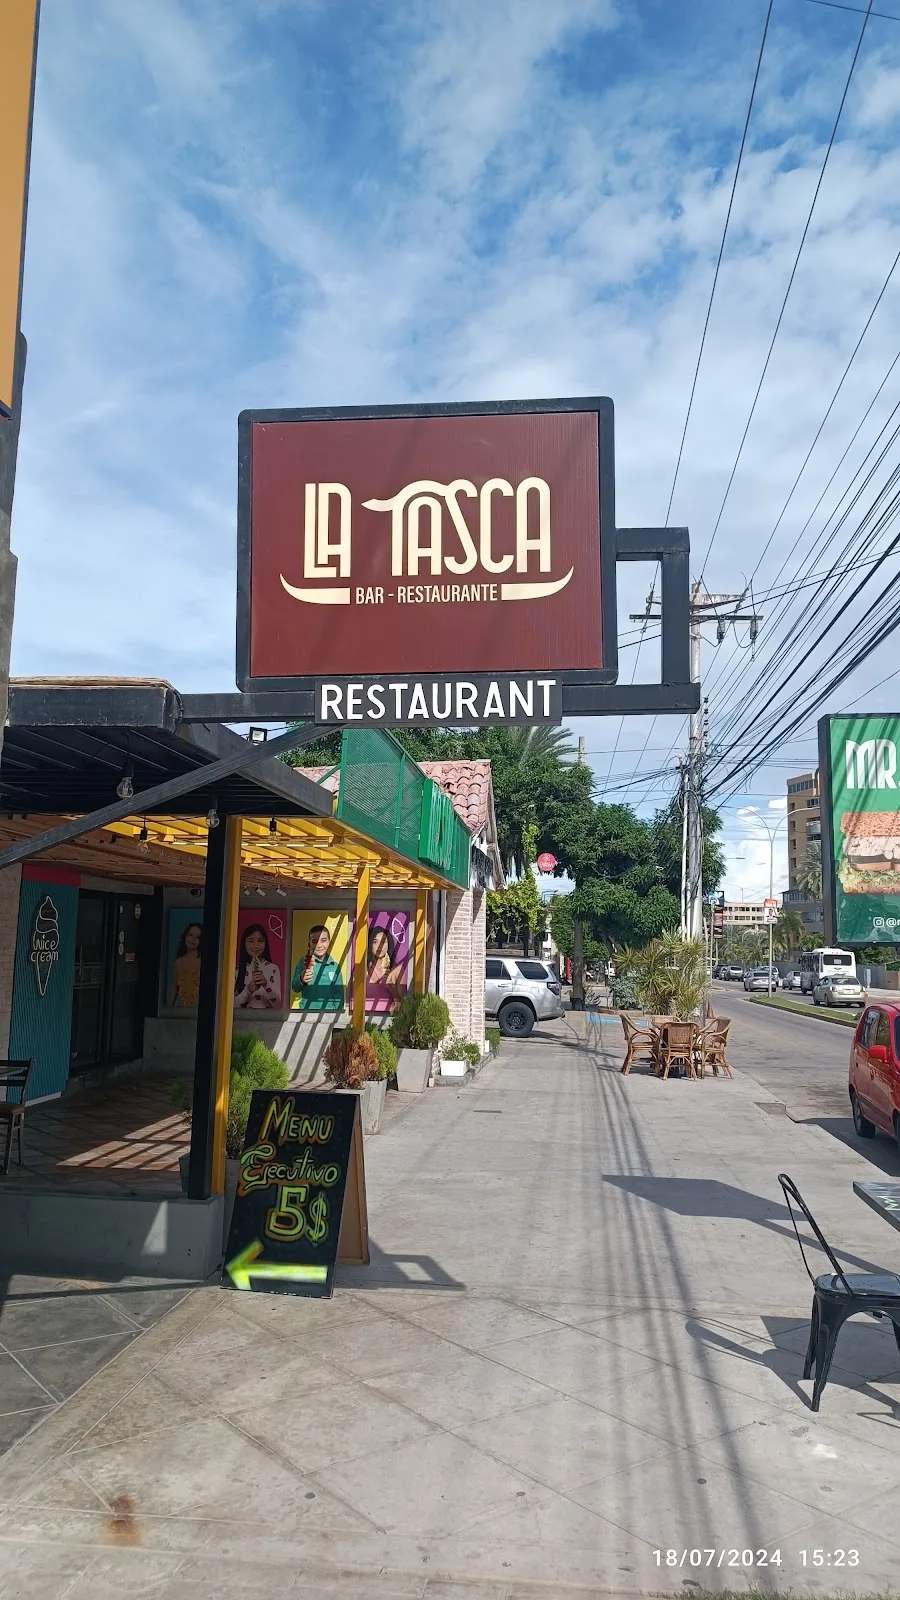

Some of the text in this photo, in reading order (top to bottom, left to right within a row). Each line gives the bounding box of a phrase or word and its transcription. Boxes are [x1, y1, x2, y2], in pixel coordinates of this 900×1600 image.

[304, 477, 551, 579] LA TASCA
[355, 587, 384, 605] BAR
[397, 584, 498, 604] RESTAURANTE
[320, 679, 557, 720] RESTAURANT
[30, 951, 59, 962] cream
[240, 1143, 339, 1192] Ejecutivo
[268, 1184, 328, 1243] 5$
